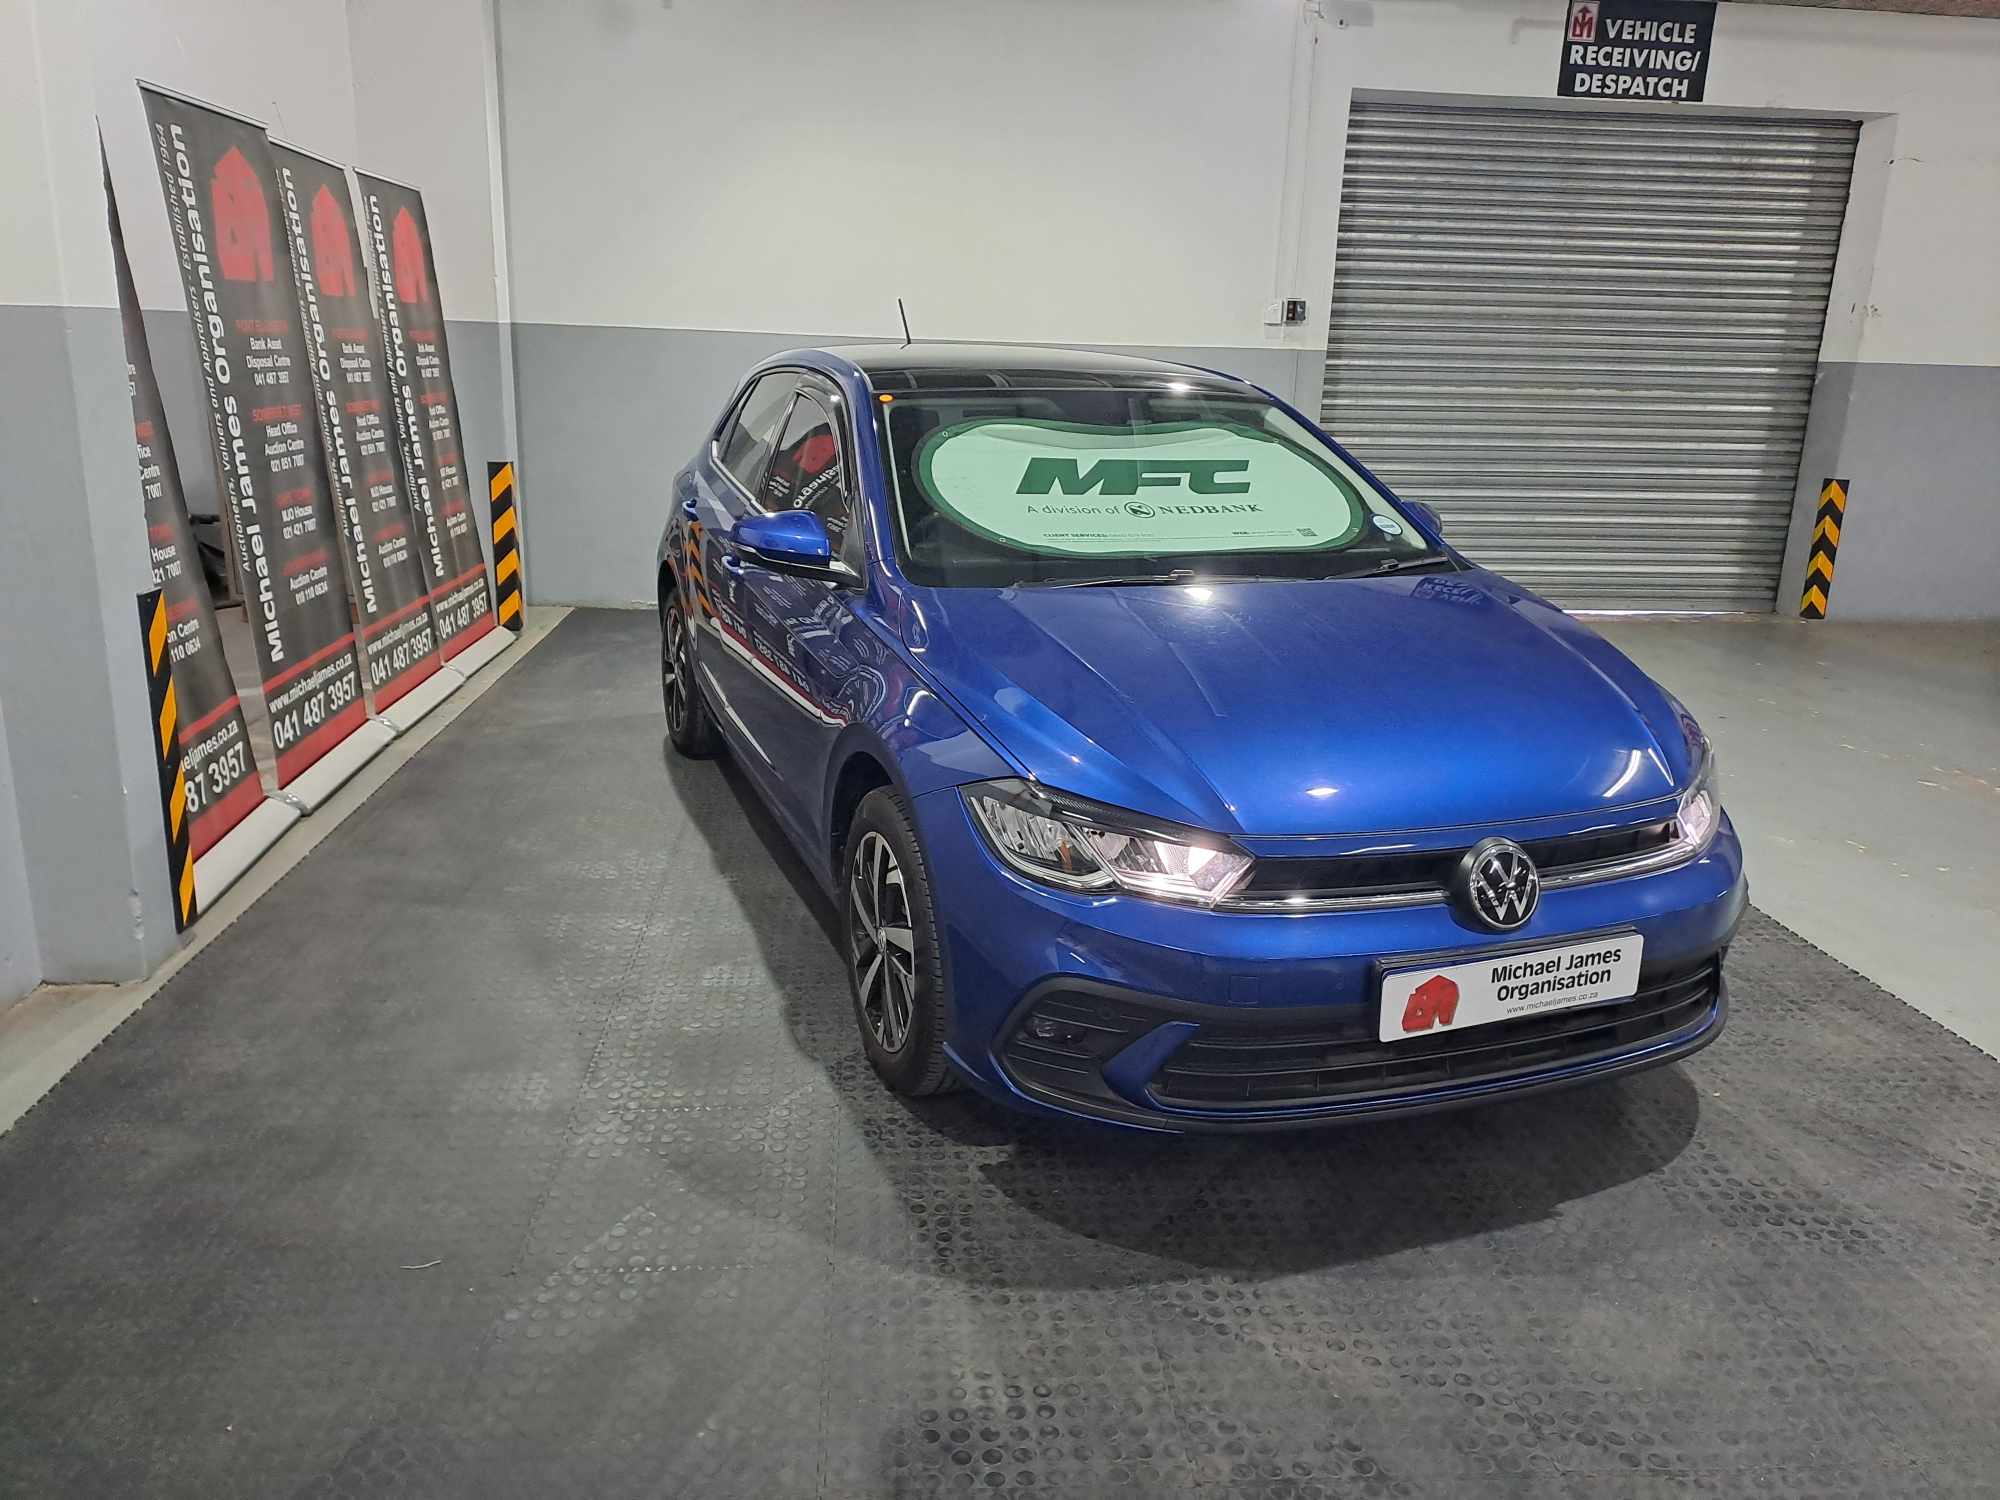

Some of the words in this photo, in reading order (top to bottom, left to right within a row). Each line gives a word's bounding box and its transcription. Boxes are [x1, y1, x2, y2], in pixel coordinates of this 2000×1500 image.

[1569, 45, 1701, 72] RECEIVING/
[1605, 19, 1697, 44] VEHICLE
[1574, 72, 1689, 98] DESPATCH
[155, 123, 172, 167] 1964
[164, 171, 192, 270] Established
[170, 124, 231, 384] Organisation
[282, 167, 331, 381] Organisation
[370, 195, 408, 377] Organisation
[189, 286, 213, 373] Appraisers
[206, 376, 219, 409] and
[388, 371, 399, 394] and
[214, 412, 231, 471] Valuers
[326, 390, 352, 489] James
[393, 395, 407, 439] Valuers
[402, 384, 425, 470] James
[224, 395, 257, 515] James
[1015, 457, 1251, 495] MFC
[227, 477, 252, 572] Auctioneers,
[417, 477, 445, 577] Michael
[1027, 505, 1038, 514] A
[1042, 504, 1102, 514] division
[1105, 505, 1121, 514] of
[1158, 503, 1264, 515] NEDBANK
[151, 544, 177, 563] House
[345, 497, 377, 613] Michael
[246, 524, 285, 663] Michael
[439, 613, 456, 639] 041
[457, 603, 470, 628] 487
[177, 618, 200, 638] Centre
[371, 653, 392, 685] 041
[393, 642, 410, 670] 487
[410, 627, 432, 659] 3957
[268, 653, 352, 714] www.michaeljames.co.za
[274, 709, 301, 749] 041
[304, 691, 326, 727] 487
[327, 671, 355, 711] 3957
[185, 772, 207, 813] 87
[208, 741, 246, 793] 3957
[1491, 956, 1562, 983] Michael
[1565, 948, 1622, 971] James
[1497, 968, 1611, 1001] Organisation
